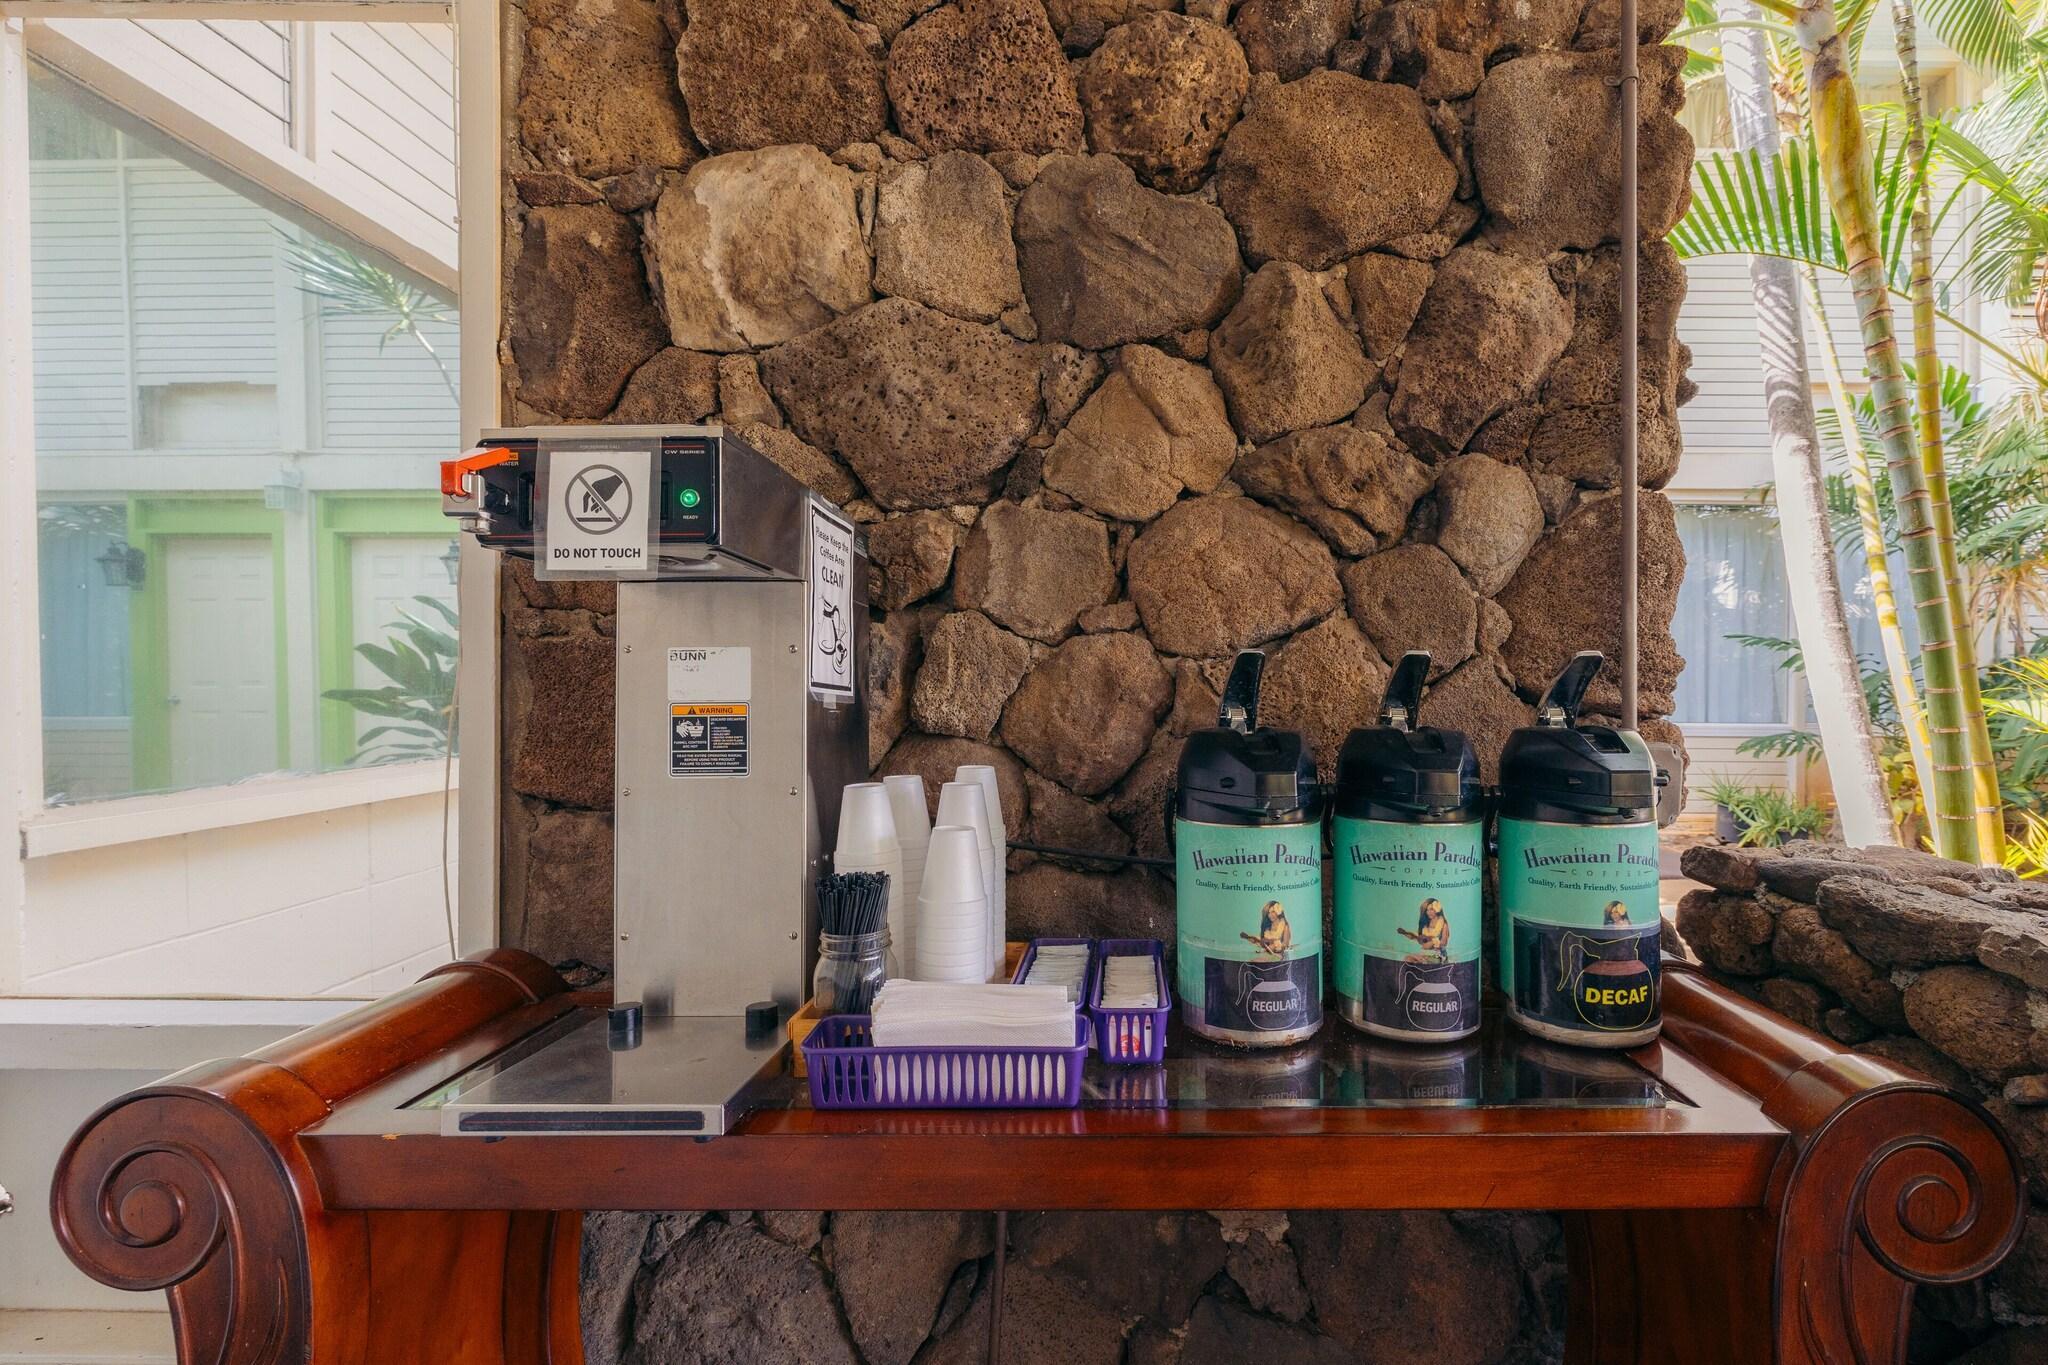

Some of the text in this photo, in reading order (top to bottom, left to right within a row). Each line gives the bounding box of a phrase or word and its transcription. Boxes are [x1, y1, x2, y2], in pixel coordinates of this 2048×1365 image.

[554, 547, 641, 559] DO NOT TOUCH
[820, 545, 834, 562] Coffee
[821, 565, 844, 590] CLEAN
[1193, 848, 1268, 870] Hawaiian
[1350, 845, 1427, 865] Hawaiian
[1524, 847, 1611, 869] Hawaiian
[1390, 866, 1459, 875] COFFEE
[1195, 878, 1219, 890] Quality,
[1221, 883, 1241, 891] Earth
[1243, 884, 1275, 892] Friendly,
[1352, 873, 1377, 885] Quality,
[1379, 878, 1399, 887] Earth
[1401, 880, 1434, 889] Friendly,
[1527, 877, 1556, 889] Quality,
[1559, 881, 1581, 890] Earth
[1583, 882, 1618, 892] Friendly,
[1585, 985, 1648, 1006] DECAF
[1252, 999, 1298, 1012] REGULAR
[1412, 1000, 1458, 1013] REGULAR
